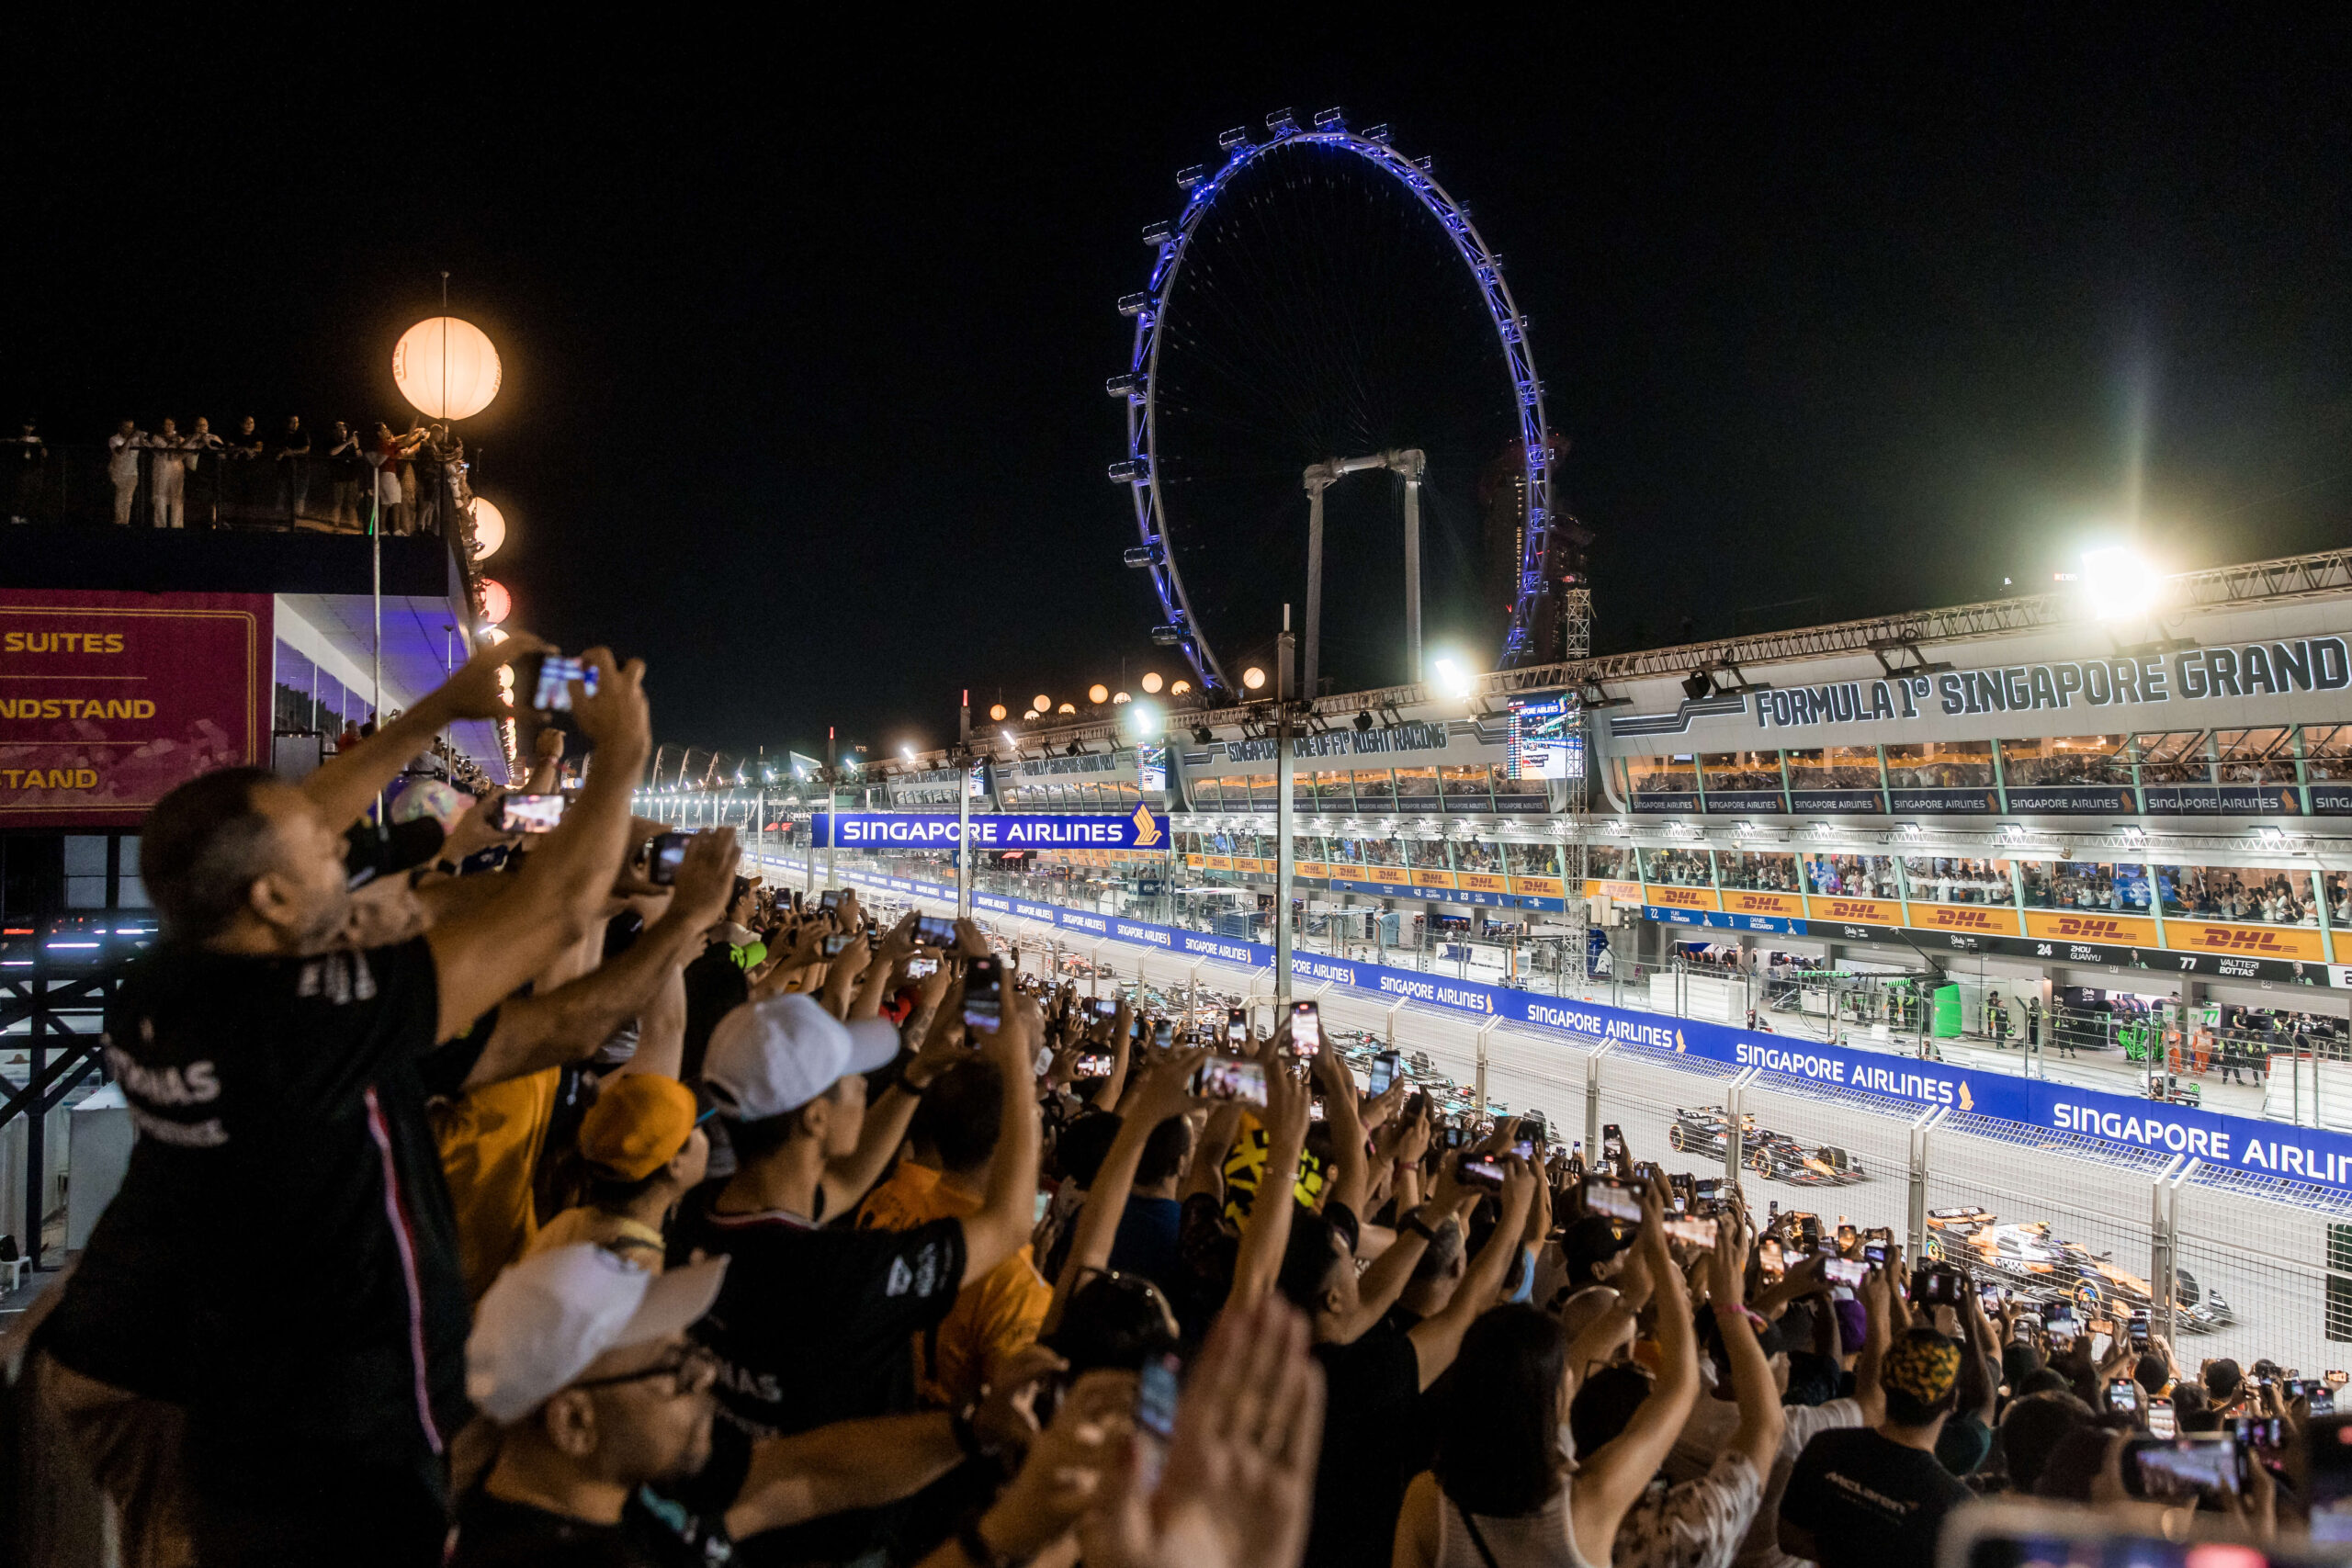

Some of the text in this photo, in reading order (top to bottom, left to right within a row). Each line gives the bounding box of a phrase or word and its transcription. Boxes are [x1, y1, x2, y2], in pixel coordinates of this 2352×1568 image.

[5, 632, 125, 653] SUITES
[1754, 680, 1896, 729] FORMULA
[1939, 654, 2170, 716] SINGAPORE
[2175, 636, 2352, 700] GRAND
[1351, 728, 1393, 755] NIGHT
[1393, 723, 1449, 752] RACING
[1633, 800, 1693, 809] SINGAPORE AIRLINES
[1709, 800, 1777, 809] SINGAPORE AIRLINES
[1794, 800, 1873, 809] SINGAPORE AIRLINES
[1894, 799, 1985, 809] SINGAPORE AIRLINES
[2010, 798, 2119, 809] SINGAPORE AIRLINES
[2149, 797, 2278, 809] SINGAPORE AIRLINES
[2316, 797, 2352, 808] SING
[843, 820, 1124, 842] SINGAPORE AIRLINES
[1340, 868, 1360, 878] DHL
[1378, 871, 1401, 882] DHL
[1422, 873, 1445, 885] DHL
[1470, 876, 1495, 889] DHL
[1523, 880, 1551, 894] DHL
[1413, 888, 1421, 897] 43
[1665, 890, 1701, 906] DHL
[1743, 896, 1784, 912] DHL
[1832, 902, 1880, 919] DHL
[1650, 908, 1659, 919] 22
[1670, 915, 1690, 923] TSUNODA
[1937, 909, 1992, 929] DHL
[1063, 913, 1103, 931] SINGAPORE AIRLINES
[1728, 916, 1735, 927] 3
[1749, 922, 1774, 931] RICCIARDO
[1117, 924, 1168, 944] SINGAPORE AIRLINES
[2058, 918, 2124, 940] DHL
[2204, 928, 2282, 952] DHL
[1185, 938, 1247, 962] SINGAPORE AIRLINES
[2037, 943, 2052, 956] 24
[2070, 945, 2092, 953] ZHOU
[2070, 953, 2102, 962] GUANYU
[2179, 956, 2198, 970] 77
[2220, 958, 2260, 970] VALTTERI
[1313, 964, 1349, 983] AIRLINES
[2219, 966, 2256, 976] BOTTAS
[1380, 976, 1485, 1010] SINGAPORE AIRLINES
[2203, 1010, 2219, 1023] 77
[1528, 1004, 1673, 1048] SINGAPORE AIRLINES
[1736, 1043, 1953, 1104] SINGAPORE AIRLINES
[2190, 1083, 2199, 1092] 20
[2053, 1102, 2231, 1160] SINGAPORE
